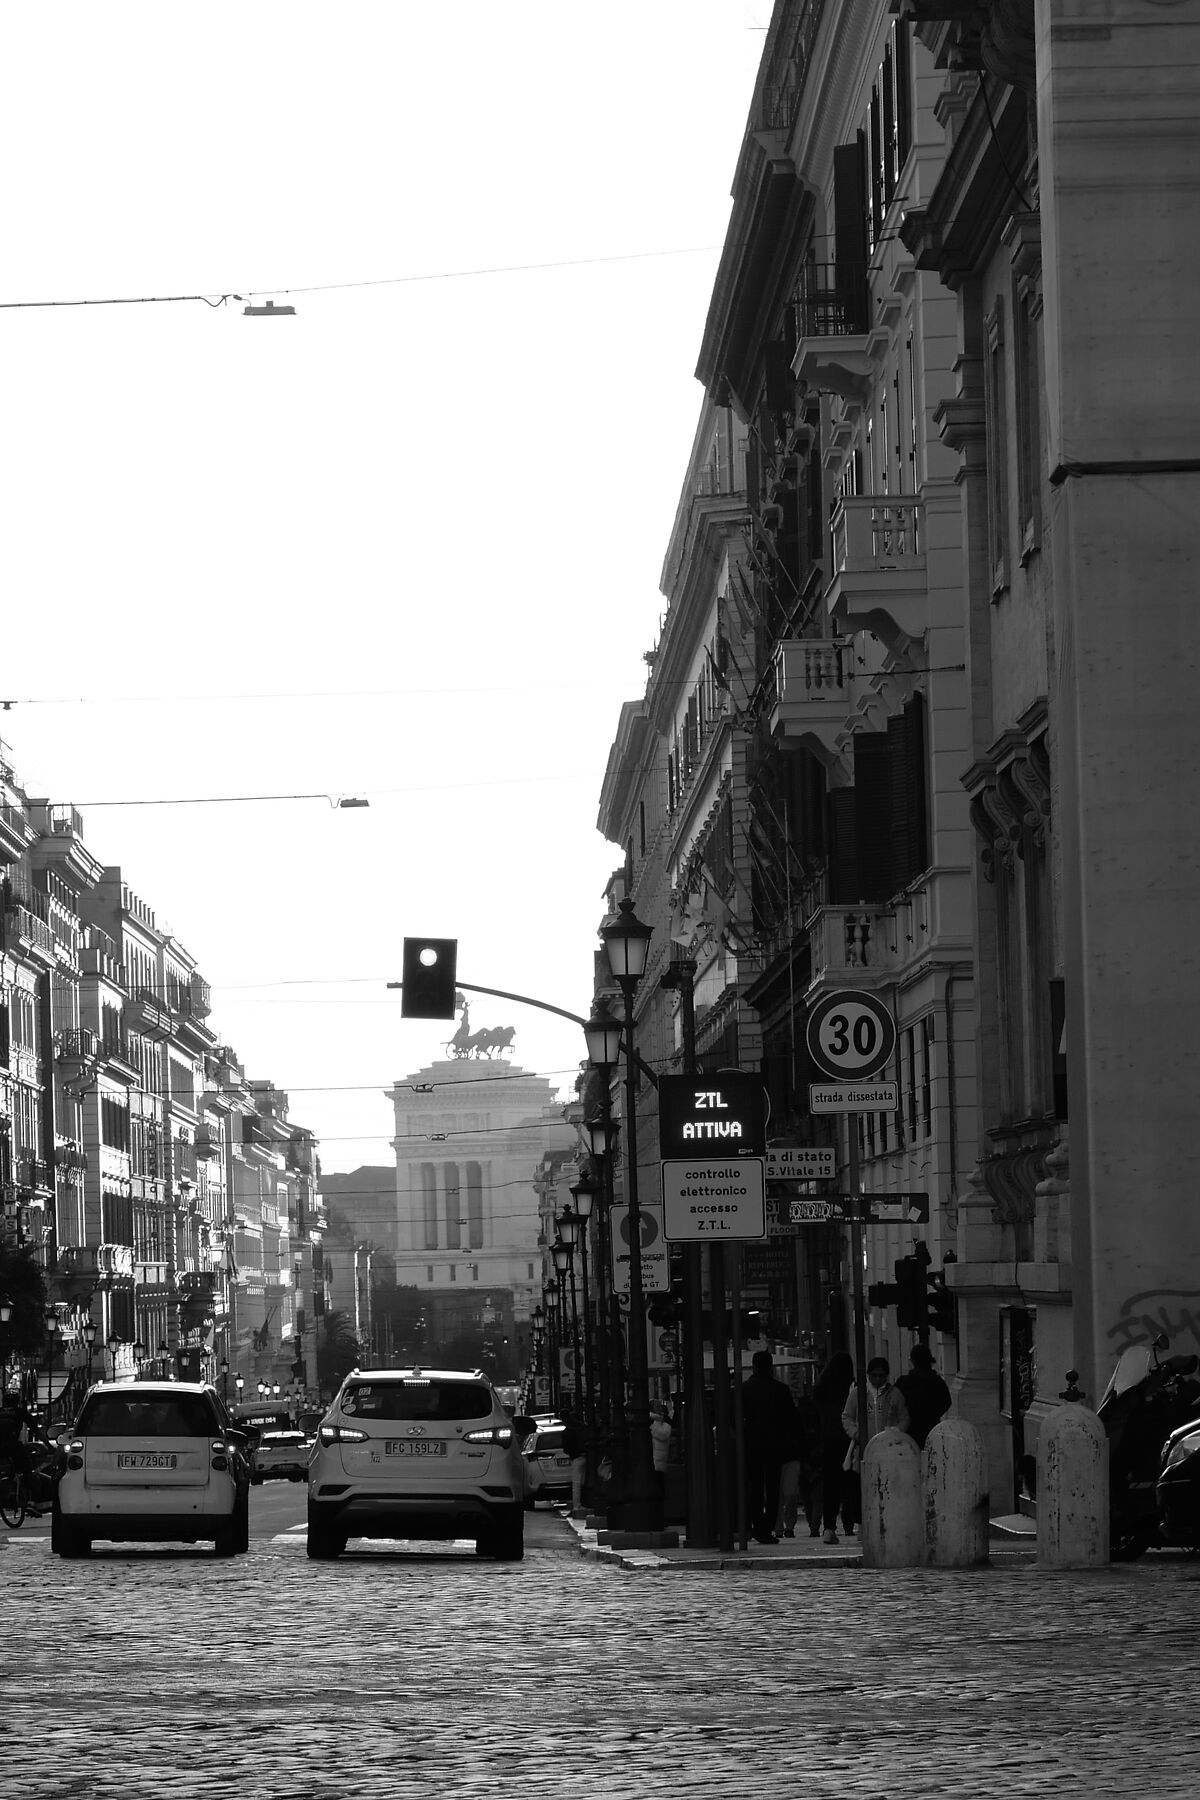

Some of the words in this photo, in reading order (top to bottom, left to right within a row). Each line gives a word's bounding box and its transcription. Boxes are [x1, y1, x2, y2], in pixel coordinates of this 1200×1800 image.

[828, 1014, 876, 1056] 30
[694, 1092, 728, 1108] ZTL
[815, 1091, 843, 1103] strada
[847, 1090, 893, 1102] dissestata
[682, 1121, 742, 1138] ATTIVA
[781, 1152, 793, 1162] di
[797, 1152, 832, 1162] stato
[685, 1168, 741, 1179] controllo
[819, 1166, 831, 1175] 15
[680, 1186, 747, 1196] elettronico
[690, 1205, 738, 1213] accesso
[698, 1220, 731, 1230] Z.T.L.
[392, 1443, 405, 1454] FG
[410, 1442, 440, 1454] 159LZ
